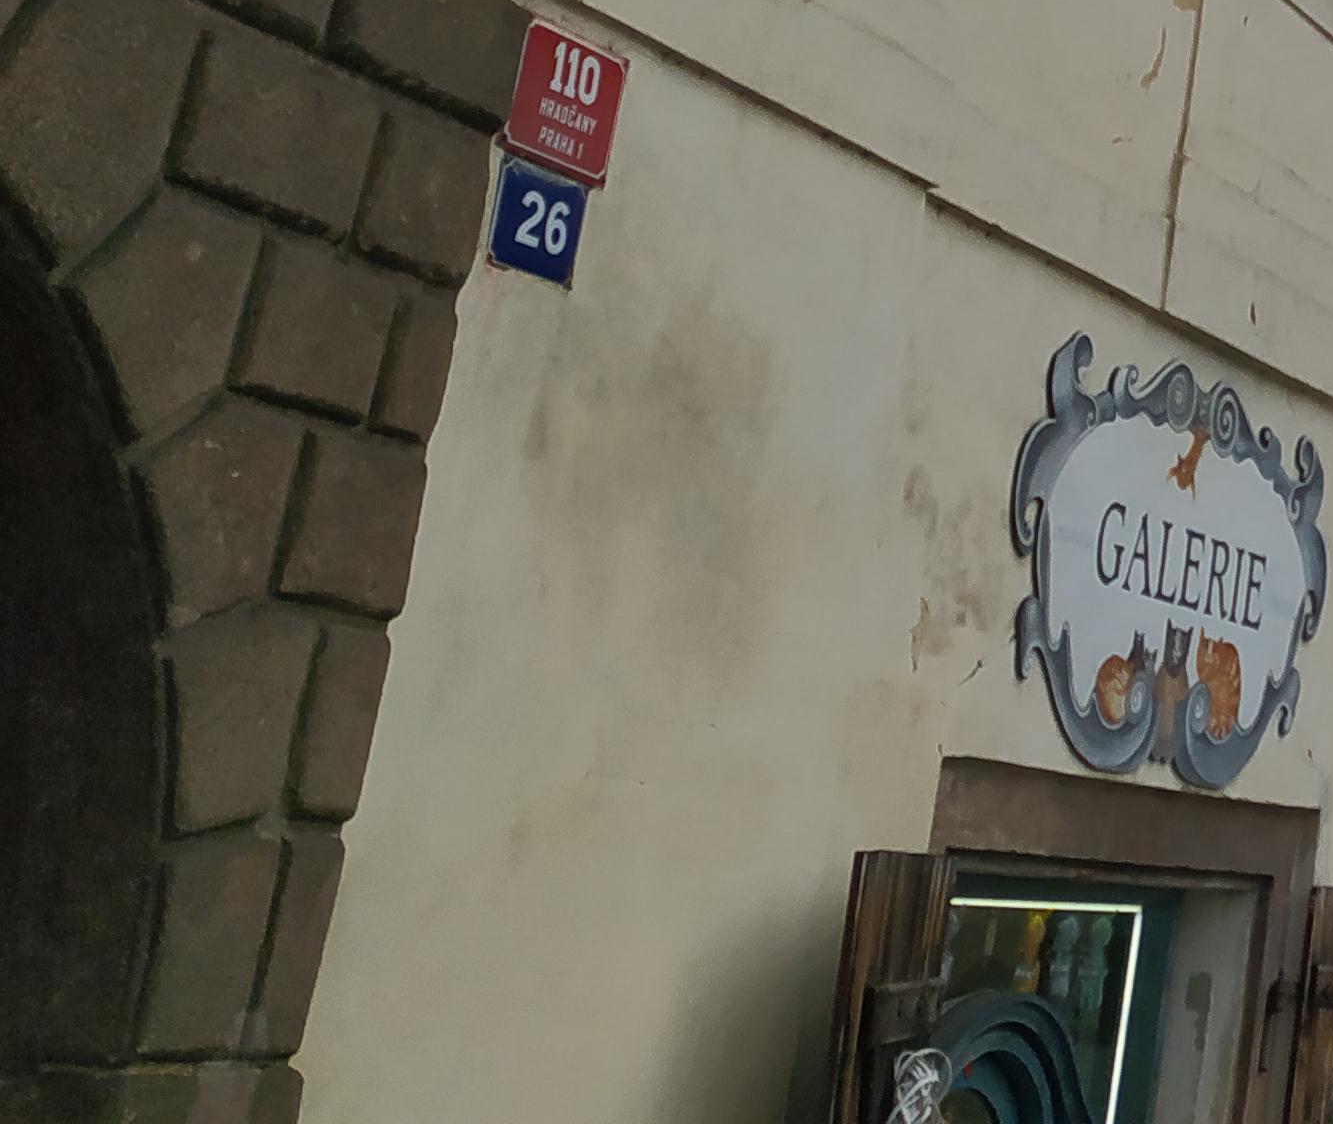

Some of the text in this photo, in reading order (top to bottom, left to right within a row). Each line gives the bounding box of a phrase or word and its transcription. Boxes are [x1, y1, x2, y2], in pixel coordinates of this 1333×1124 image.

[549, 41, 601, 106] 110
[538, 96, 597, 136] HRADČANY
[538, 126, 584, 160] PRAHA 1
[514, 190, 571, 256] 26
[1096, 501, 1268, 631] GALERIE
